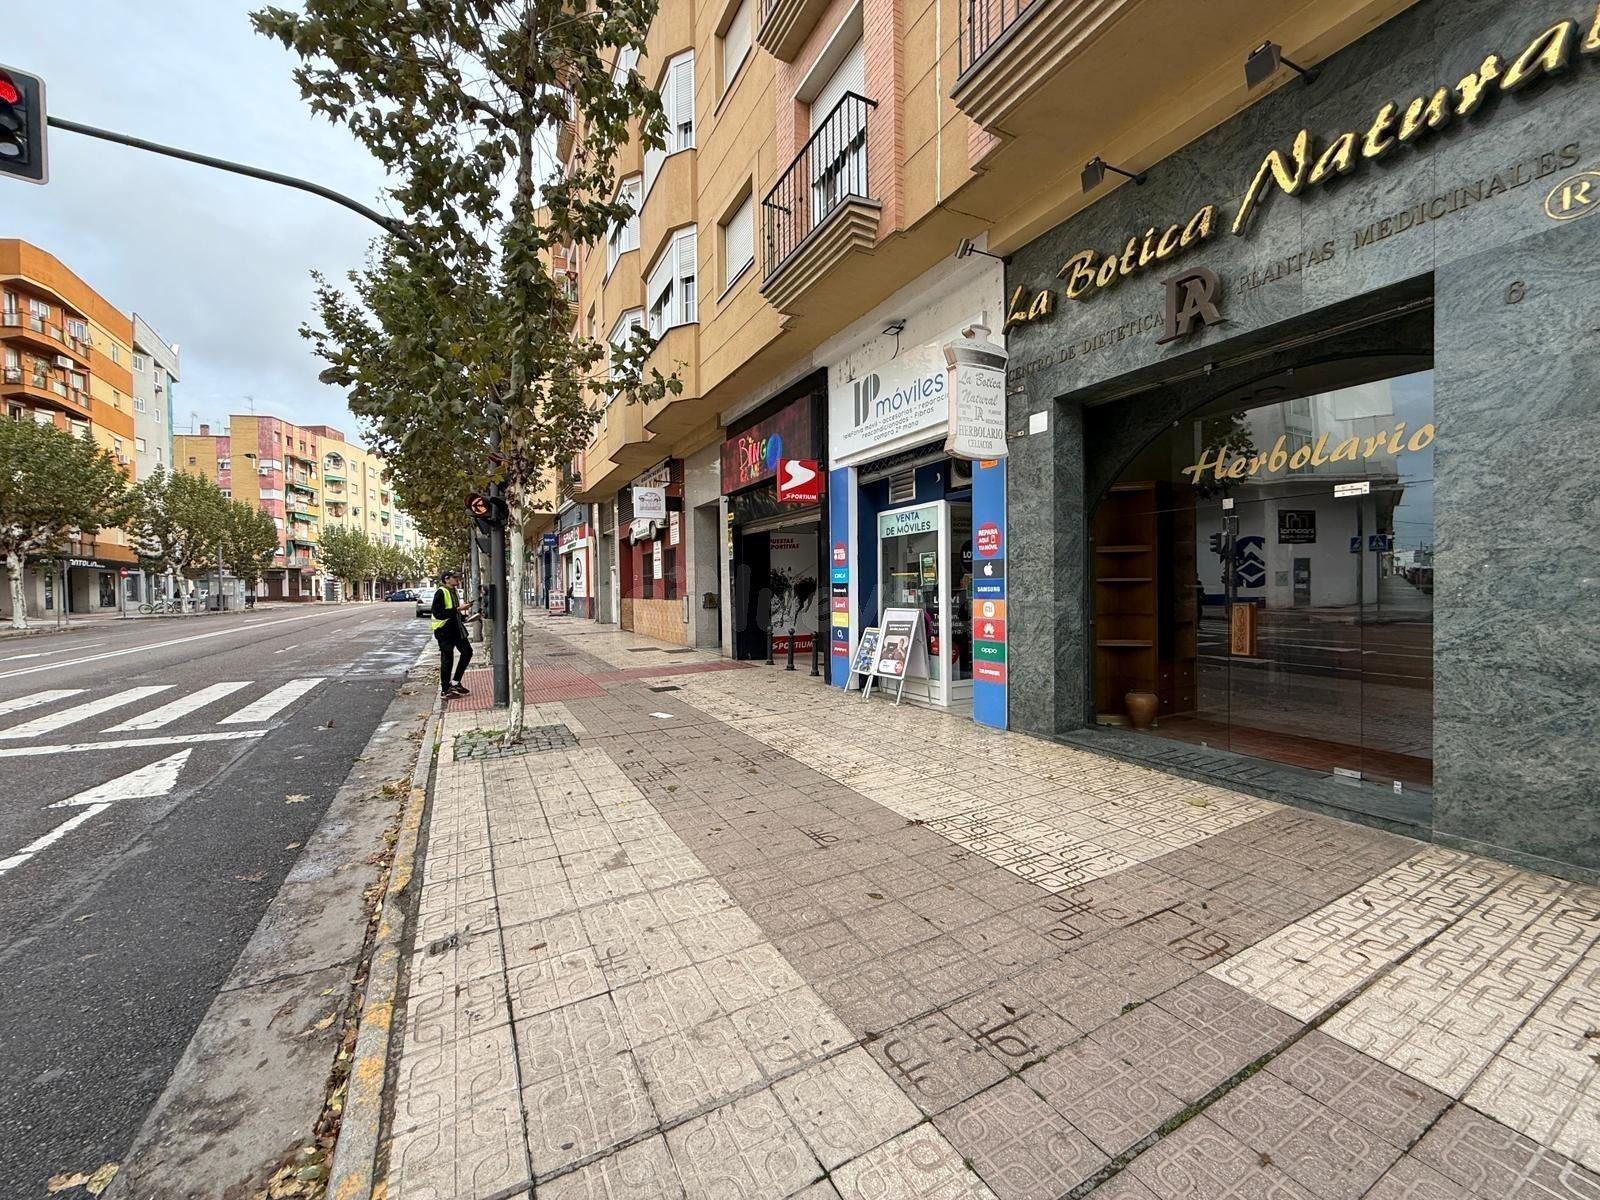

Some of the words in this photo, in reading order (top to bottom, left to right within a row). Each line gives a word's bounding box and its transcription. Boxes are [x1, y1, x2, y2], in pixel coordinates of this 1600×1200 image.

[1237, 240, 1336, 295] PLANTAS
[1353, 141, 1582, 250] MEDICINALES
[1003, 283, 1050, 335] La
[1056, 202, 1219, 300] Botica
[1504, 281, 1526, 304] 6
[1059, 345, 1077, 364] DE
[1082, 311, 1165, 355] DIETETICA
[975, 373, 1002, 390] Botica
[876, 373, 944, 418] móviles
[961, 389, 999, 407] Natural
[958, 424, 1003, 440] HERBOLARIO
[1180, 422, 1437, 485] Herbolario
[896, 512, 920, 523] VENTA
[886, 527, 895, 536] DE
[897, 521, 931, 534] MÓVILES
[978, 528, 998, 536] REPARA
[772, 640, 814, 650] SPOTIUM
